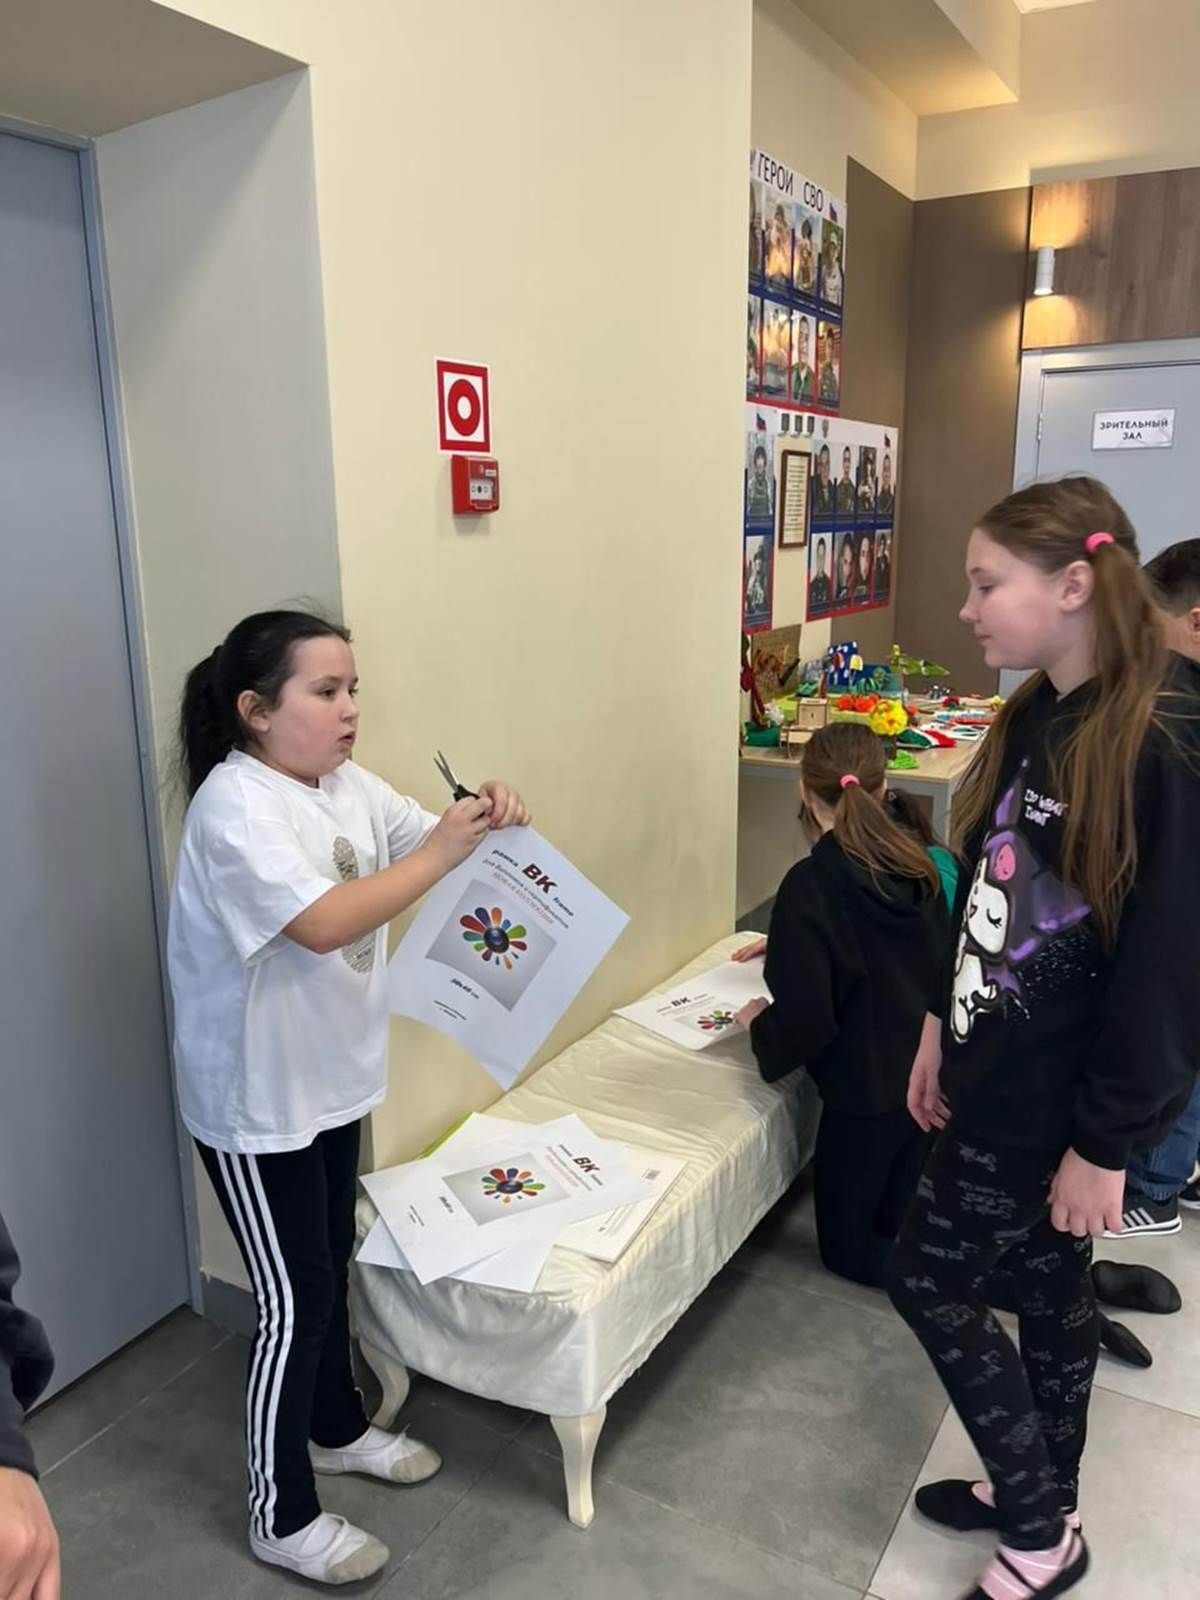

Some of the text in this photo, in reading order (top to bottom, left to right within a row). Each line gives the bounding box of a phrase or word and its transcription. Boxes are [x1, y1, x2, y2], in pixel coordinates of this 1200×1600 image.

[758, 152, 793, 196] ГЕРОИ
[803, 181, 824, 212] СВО
[1099, 417, 1168, 430] ЗРИТЕЛЬНЫЙ
[1122, 431, 1142, 441] ЗАЛ
